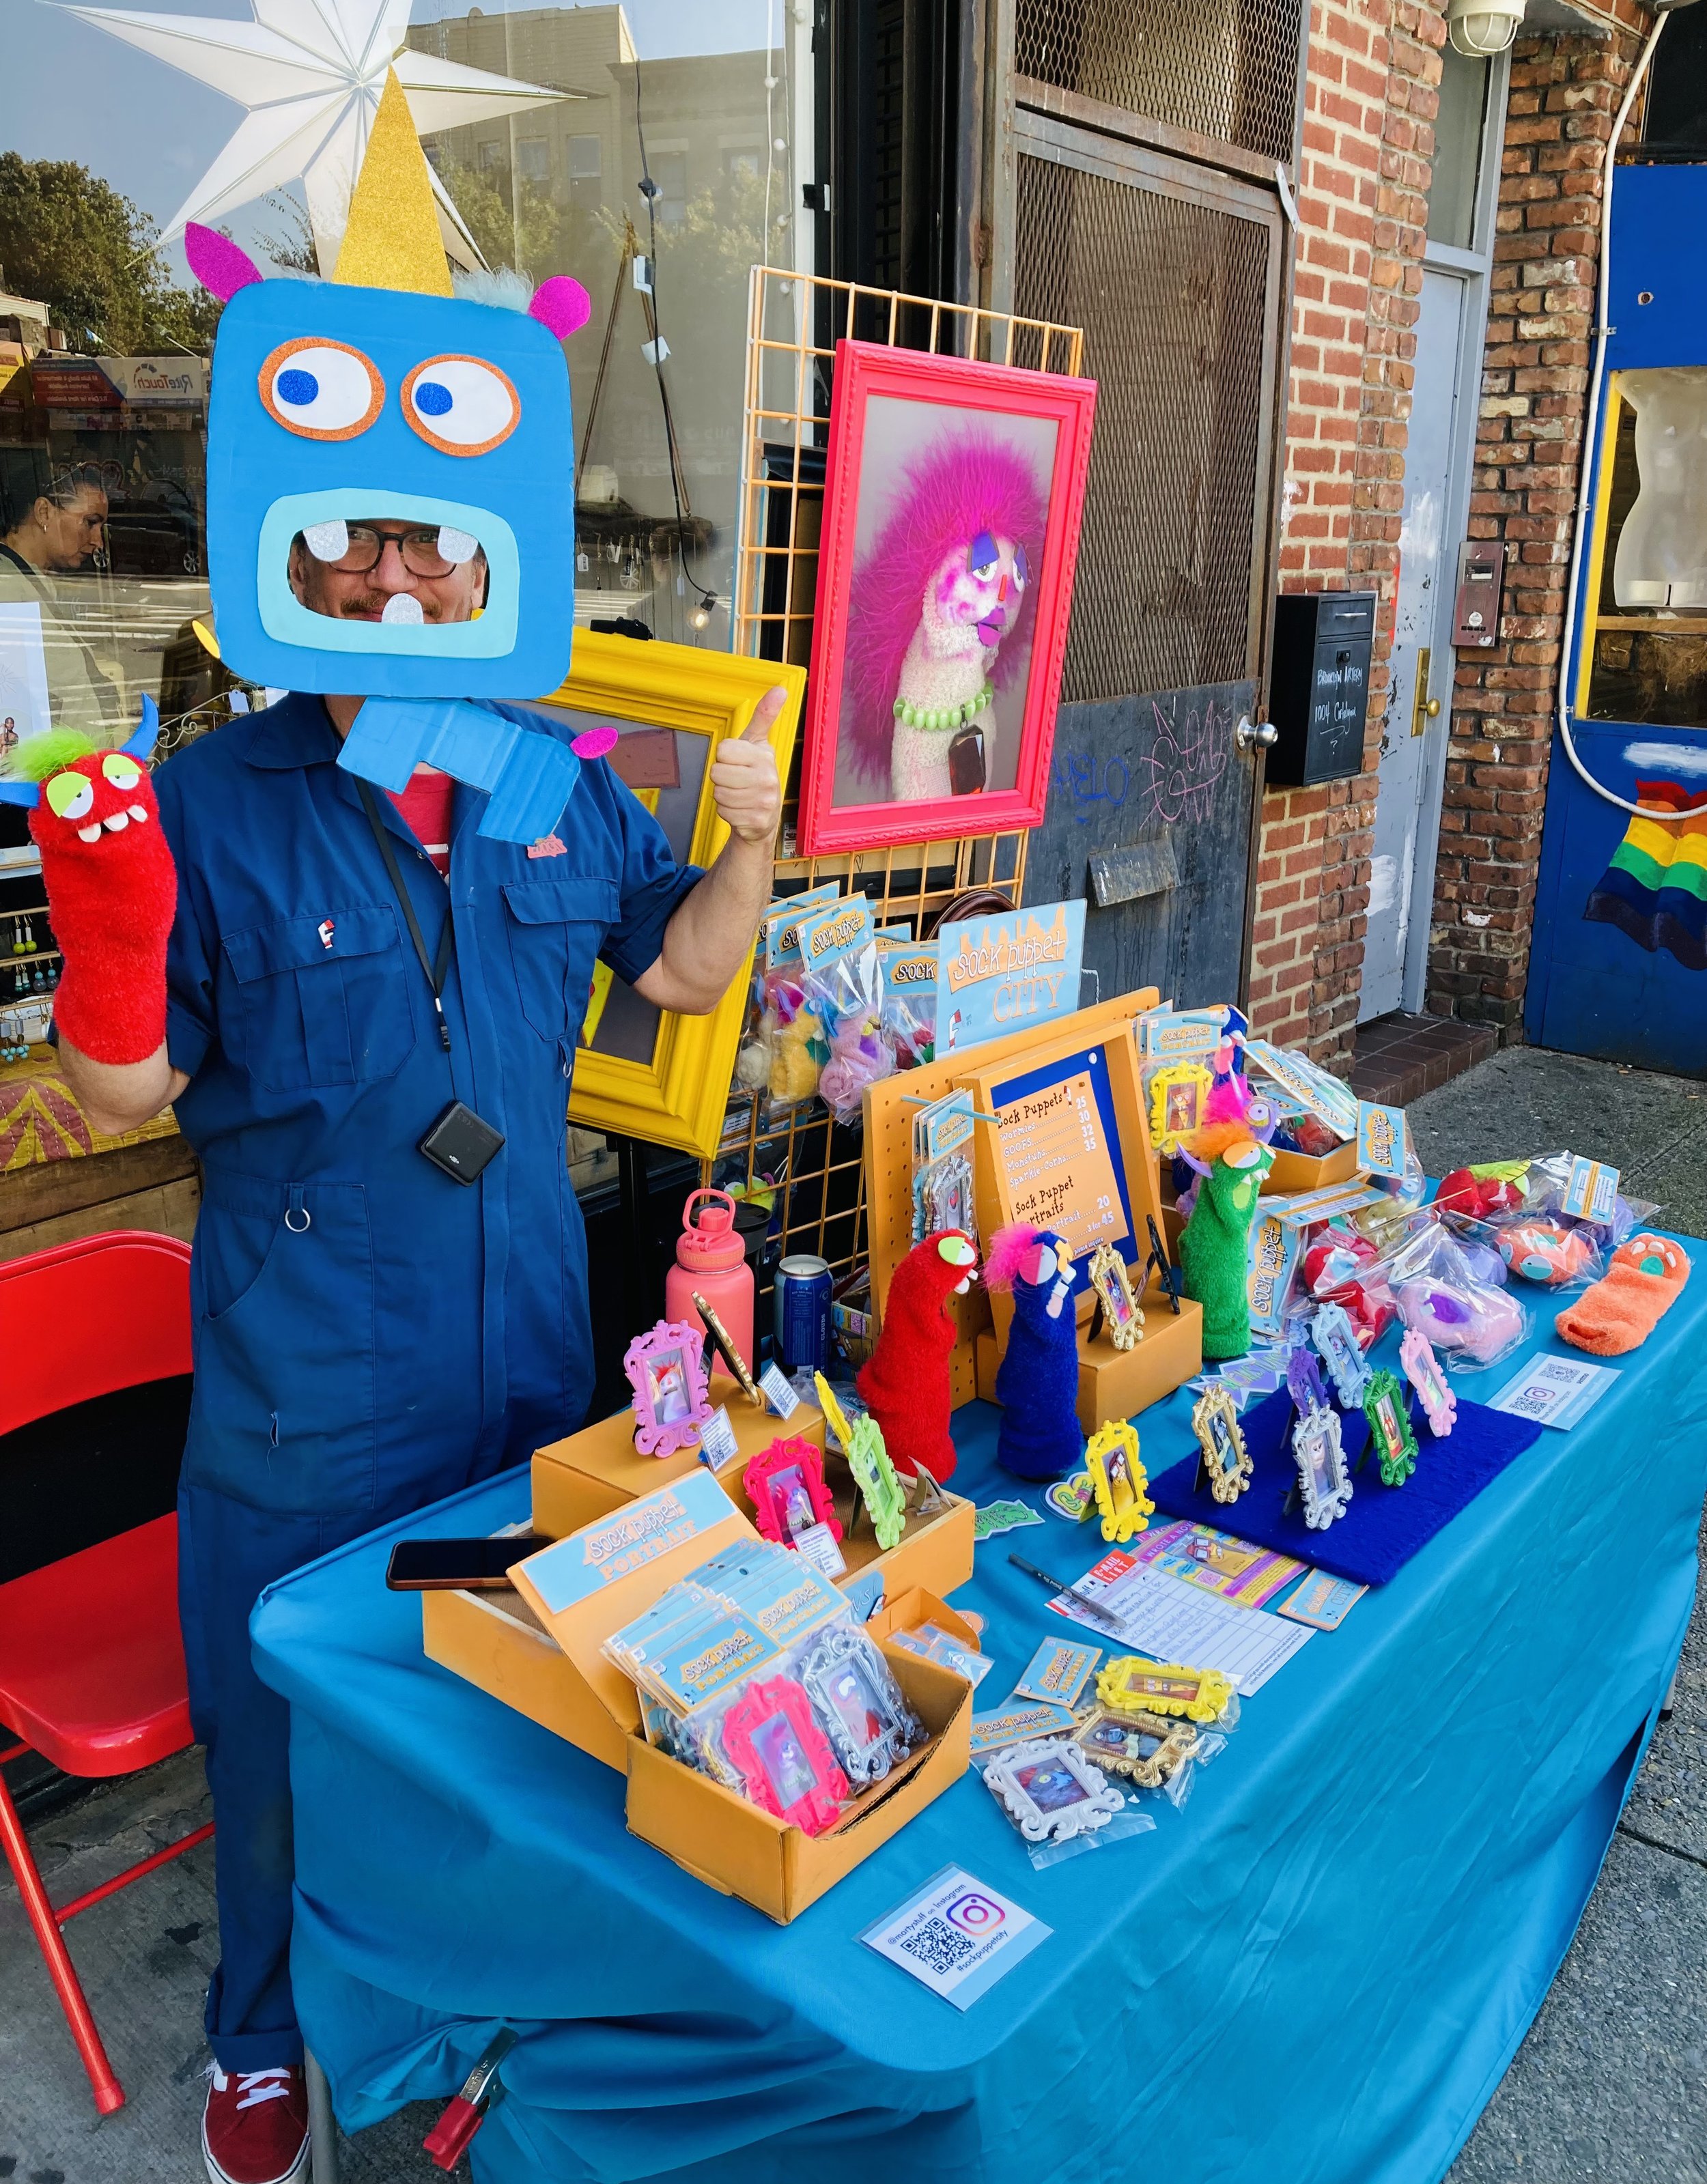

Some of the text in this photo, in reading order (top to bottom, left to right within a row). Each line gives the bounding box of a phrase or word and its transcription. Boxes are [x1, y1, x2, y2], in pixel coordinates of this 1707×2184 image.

[813, 911, 862, 953] SOCK puppet
[953, 929, 1067, 982] SOCK puppet
[897, 961, 937, 981] SOCK
[993, 972, 1067, 1023] CITY
[1161, 1026, 1210, 1042] SOCK puppet
[1263, 1055, 1343, 1122] SOCK puppet
[1024, 1092, 1063, 1120] Puppets
[1075, 1096, 1087, 1110] 25
[1004, 1110, 1090, 1158] GOOFS 30
[1081, 1124, 1094, 1138] 32
[1084, 1137, 1097, 1152] 35
[1371, 1138, 1390, 1165] SOCK
[1015, 1175, 1075, 1215] Sock Puppet
[1097, 1194, 1110, 1210] 20
[1024, 1200, 1064, 1227] ortraits
[1101, 1210, 1115, 1226] 45
[1252, 1225, 1288, 1313] SOCK puppet
[589, 1499, 681, 1559] SOCK puppet
[598, 1518, 699, 1582] PORTRAIT
[1146, 1536, 1172, 1558] WROTE
[1168, 1533, 1177, 1542] A
[1094, 1555, 1121, 1578] E-MAIL
[1102, 1561, 1130, 1584] LIST
[761, 1583, 817, 1628] SOCK puppet
[1330, 1581, 1355, 1606] CITY
[684, 1632, 750, 1680] SOCK puppet
[1044, 1669, 1060, 1688] SOCK
[976, 1707, 1053, 1734] SOCK puppet
[888, 1883, 966, 1945] @martystuff on Instagram
[957, 1929, 1008, 1972] #sockpuppetcity
